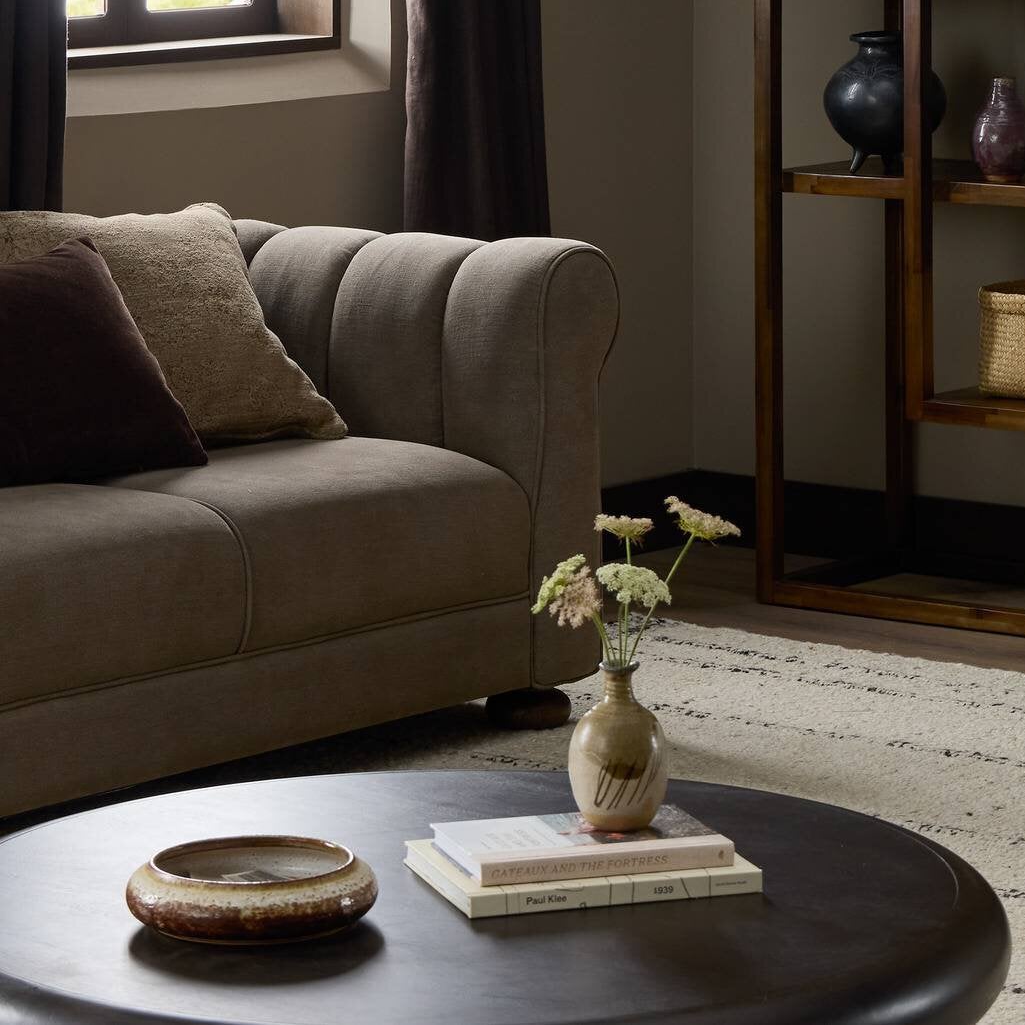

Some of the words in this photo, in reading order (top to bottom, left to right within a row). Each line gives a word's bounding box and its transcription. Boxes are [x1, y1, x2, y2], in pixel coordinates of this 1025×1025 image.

[552, 862, 576, 874] AND
[580, 860, 604, 872] THE
[607, 855, 669, 870] FORTRESS
[653, 885, 674, 895] 1939
[526, 894, 546, 905] Paul
[547, 893, 567, 904] Klee
